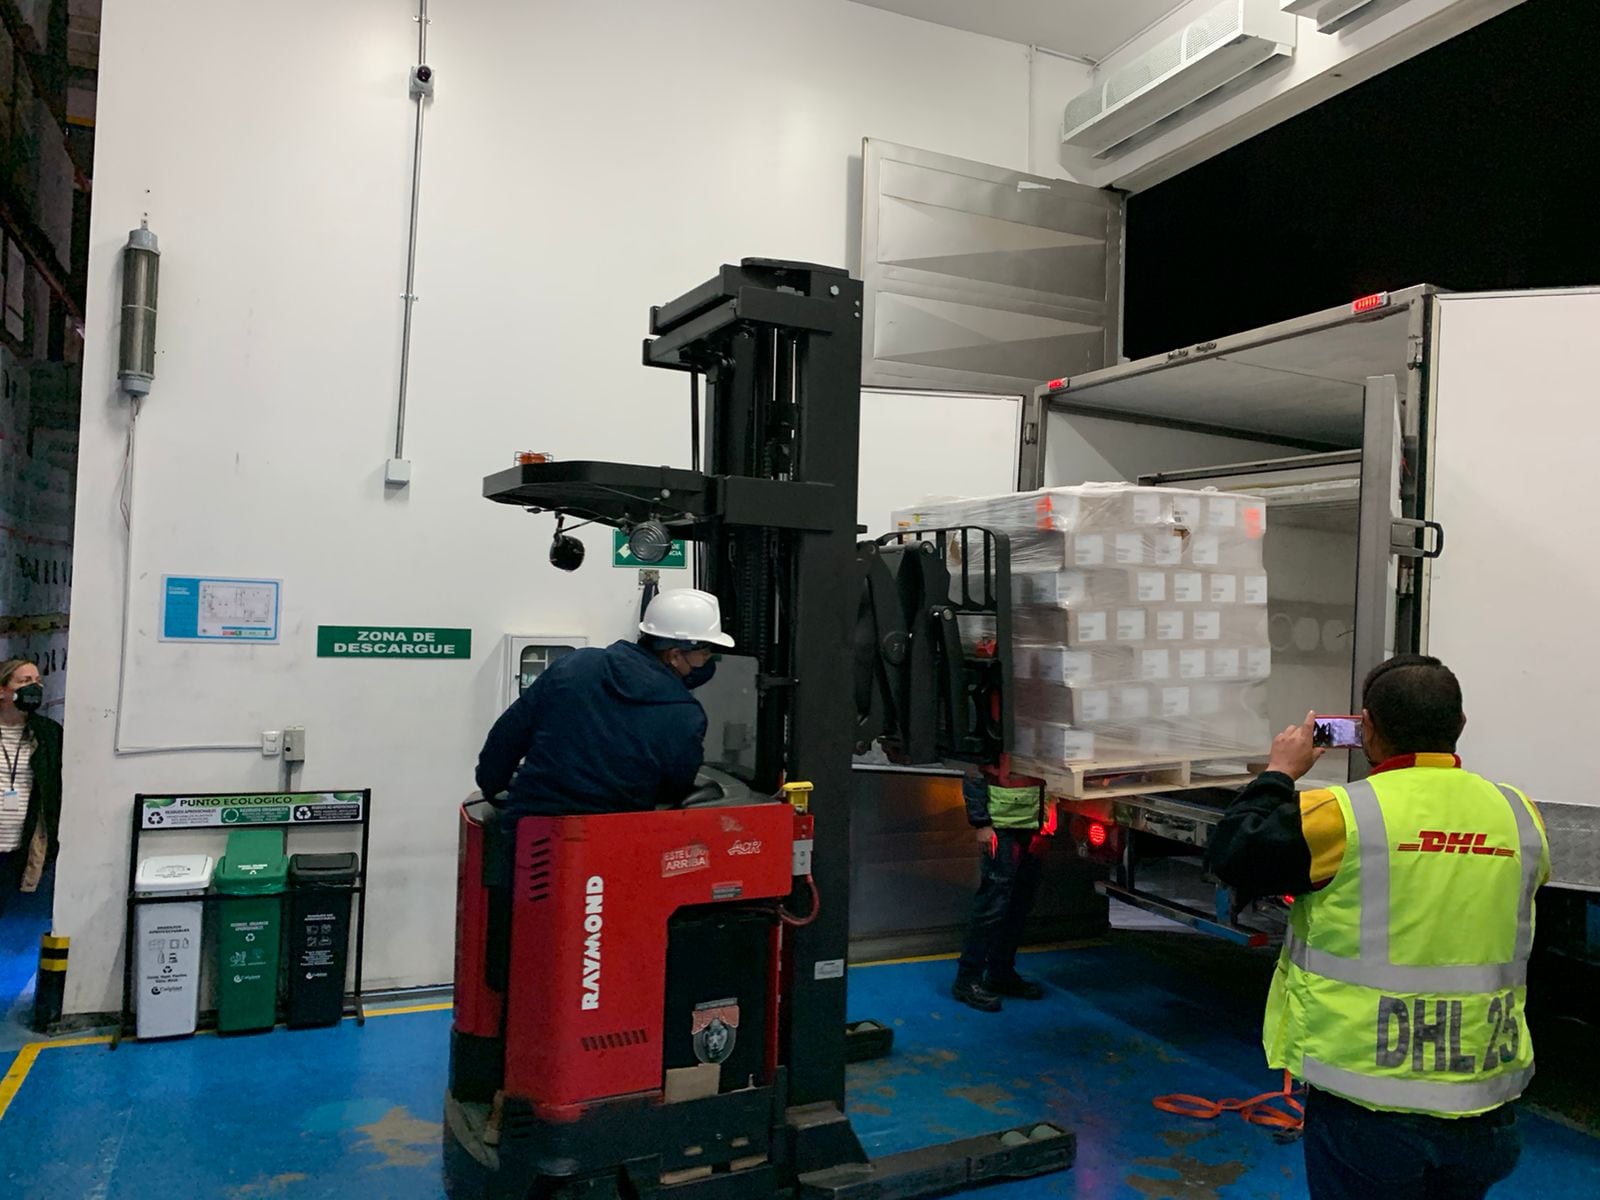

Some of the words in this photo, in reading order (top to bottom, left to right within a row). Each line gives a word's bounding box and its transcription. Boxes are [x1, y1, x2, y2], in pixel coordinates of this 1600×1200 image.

[357, 631, 407, 642] ZONA
[413, 632, 436, 642] DE
[334, 643, 455, 654] DESCARGUE
[180, 798, 221, 807] PUNTO
[223, 796, 293, 806] ECOLOGICO
[1418, 831, 1496, 855] DHL
[664, 849, 685, 861] ESTE
[665, 857, 706, 871] ARRBA
[581, 875, 604, 1011] RAYMOND
[1376, 995, 1476, 1074] DHL
[1482, 991, 1520, 1071] 25
